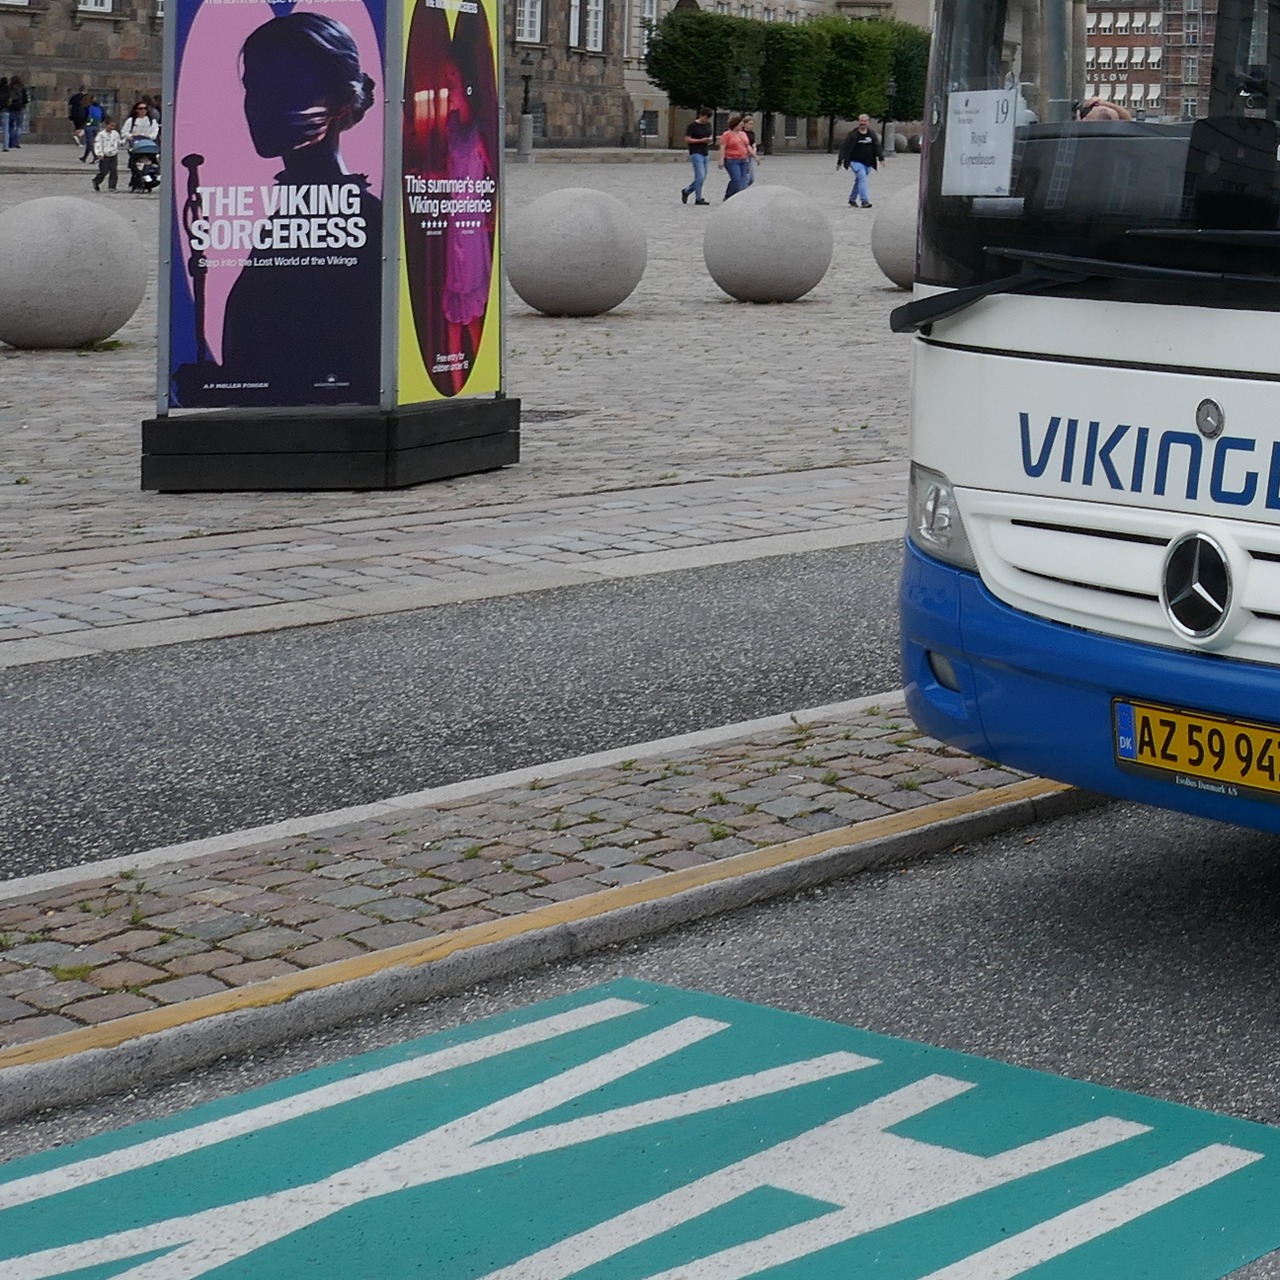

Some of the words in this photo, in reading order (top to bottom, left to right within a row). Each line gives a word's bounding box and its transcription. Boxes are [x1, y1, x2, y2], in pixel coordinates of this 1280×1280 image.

[995, 99, 1009, 124] 19
[970, 131, 988, 147] Royal
[960, 153, 996, 168] Copenhagen
[404, 175, 426, 193] This
[427, 176, 474, 193] summer's
[475, 176, 495, 197] epic
[196, 186, 254, 217] THE
[260, 183, 361, 216] VIKING
[408, 196, 439, 217] Viking
[440, 196, 492, 217] experience
[190, 217, 367, 251] SORCERESS
[198, 258, 220, 268] Step
[220, 258, 237, 267] into
[238, 258, 252, 267] the
[254, 257, 273, 266] Lost
[274, 257, 299, 266] World
[300, 257, 310, 266] of
[310, 257, 325, 266] the
[326, 256, 358, 267] Vikings
[1119, 735, 1132, 750] DK
[1137, 715, 1178, 763] AZ
[1187, 723, 1226, 773] 59
[1197, 780, 1226, 794] Danmark
